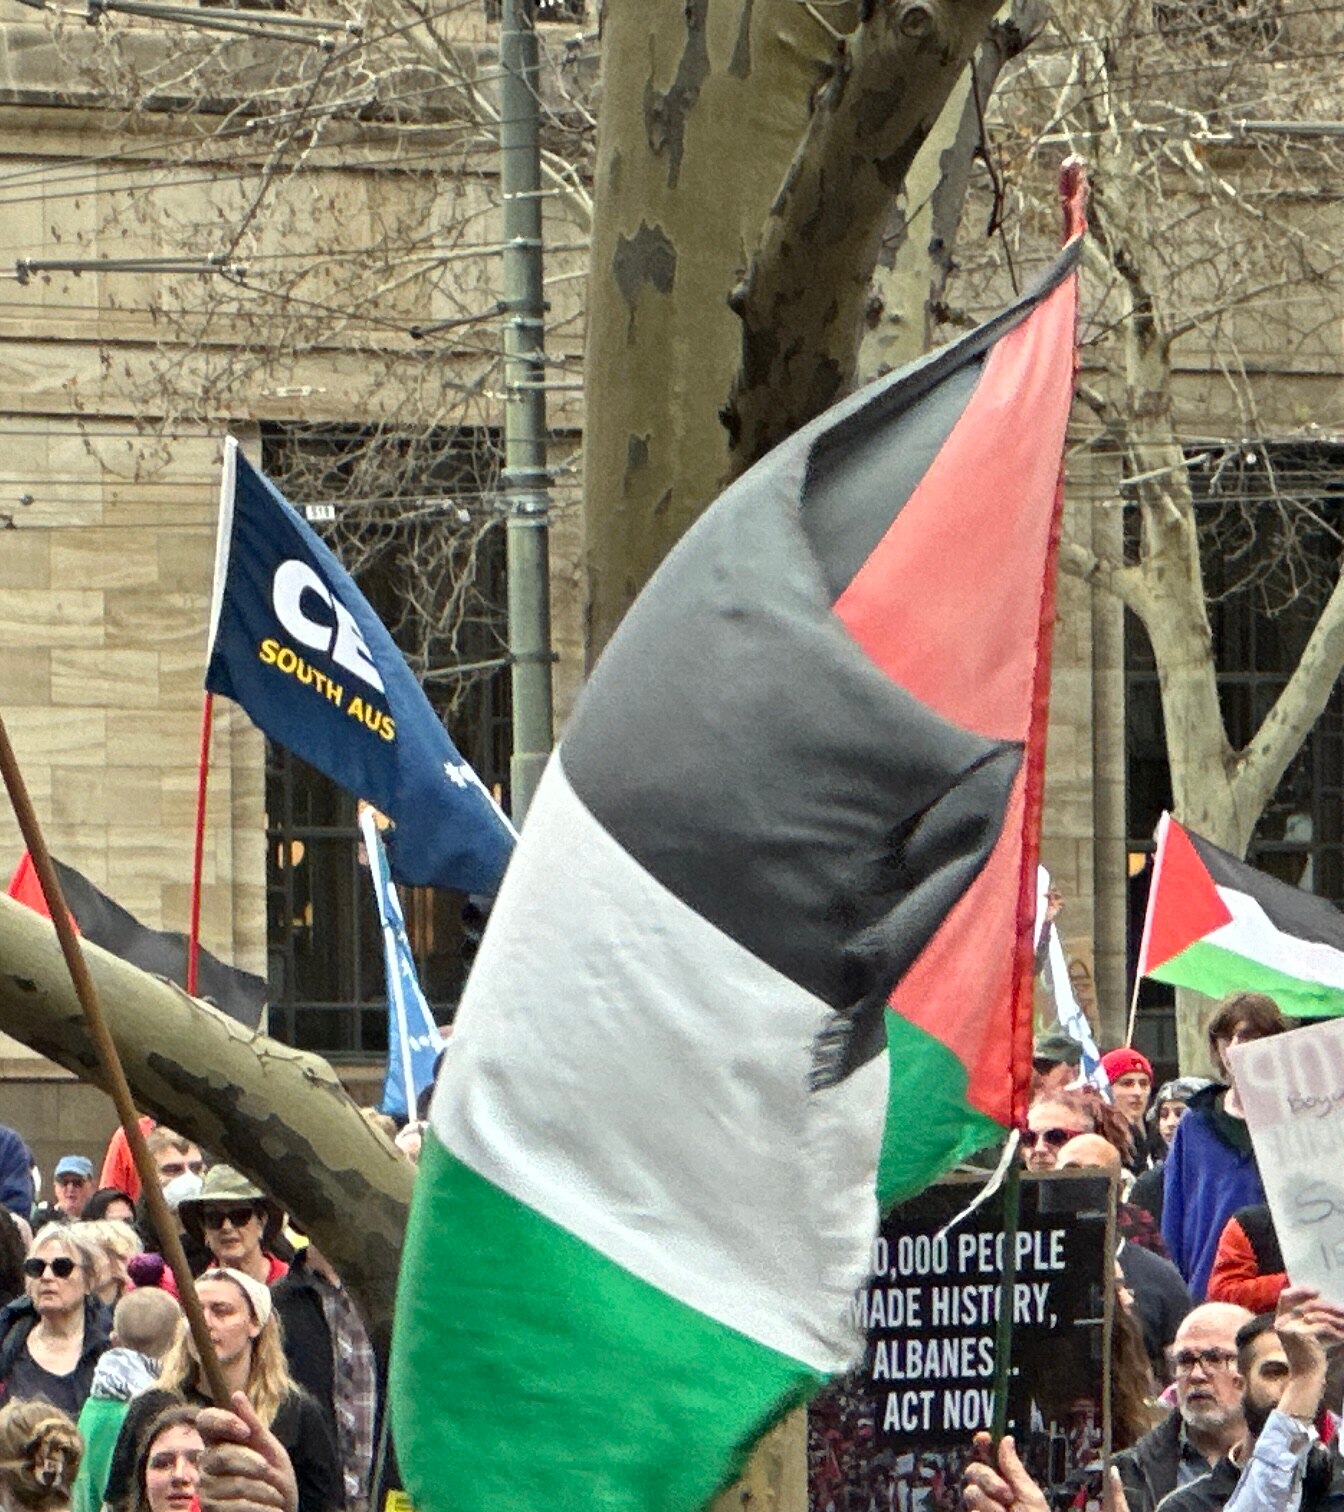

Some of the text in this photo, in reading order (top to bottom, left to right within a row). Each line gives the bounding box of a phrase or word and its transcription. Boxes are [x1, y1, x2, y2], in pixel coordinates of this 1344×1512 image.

[259, 638, 344, 707] SOUTH
[872, 1233, 949, 1282] 0,000
[882, 1390, 936, 1432] ACT
